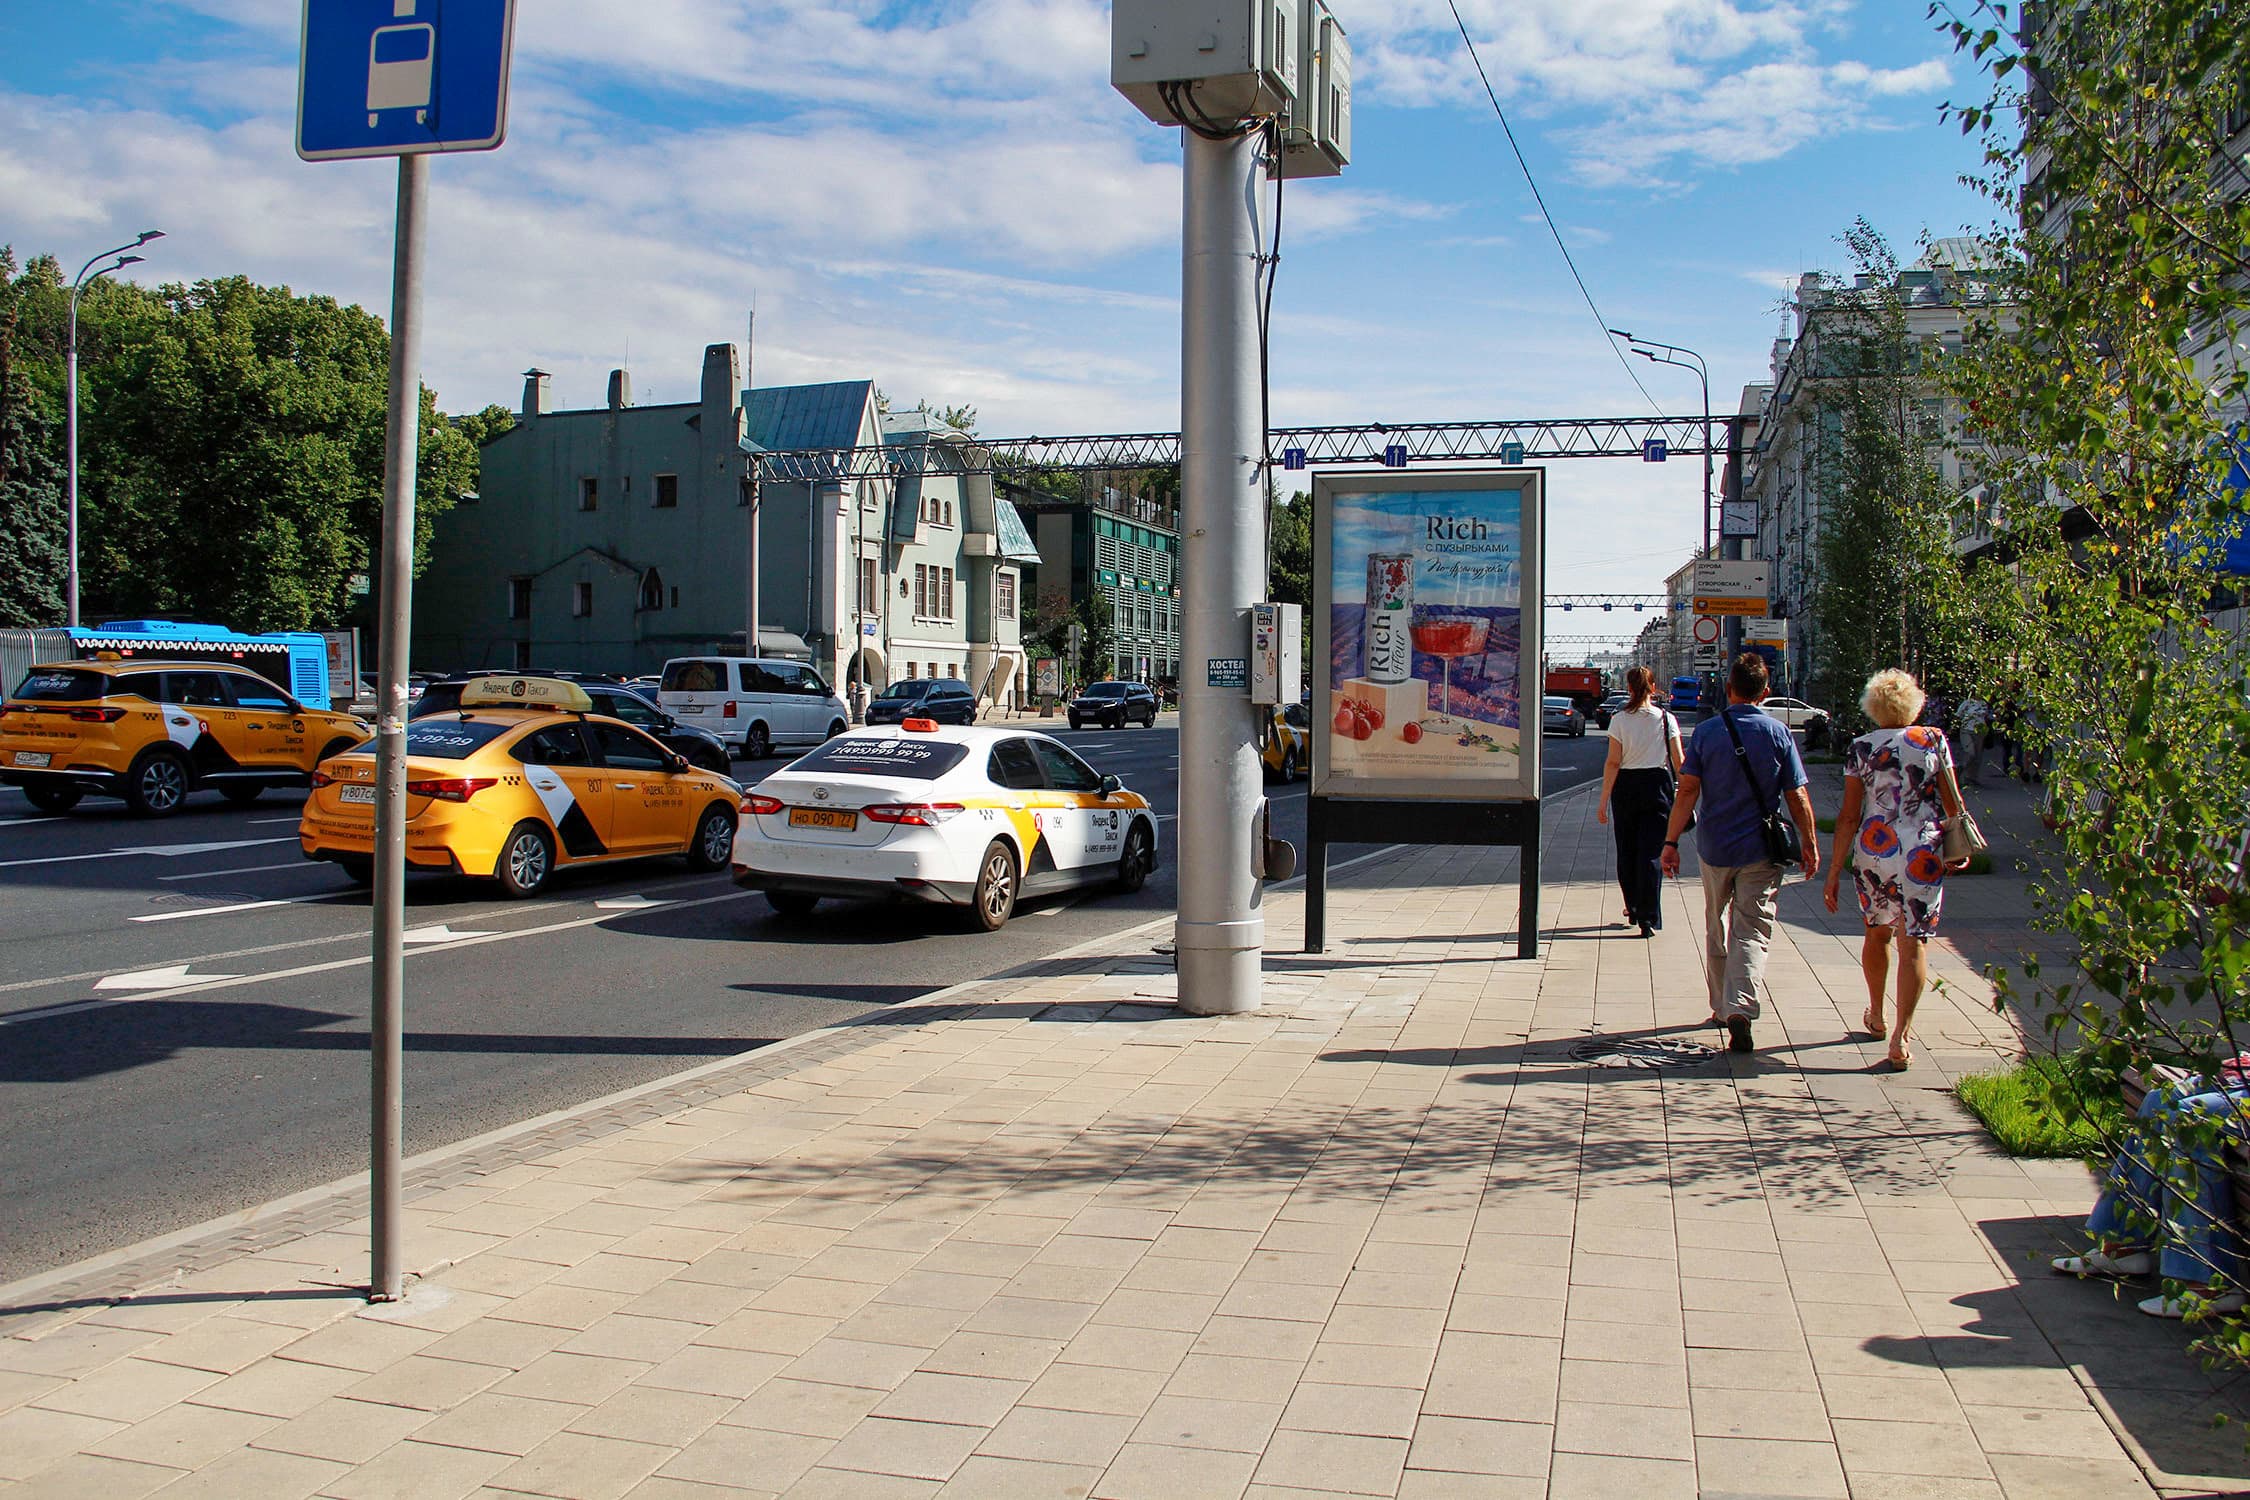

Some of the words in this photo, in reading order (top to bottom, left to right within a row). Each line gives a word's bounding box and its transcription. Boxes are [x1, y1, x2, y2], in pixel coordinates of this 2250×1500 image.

[1427, 516, 1487, 540] Rich
[1425, 543, 1433, 553] С
[1435, 543, 1509, 553] ПУЗЫРЬКАМИ
[1370, 615, 1391, 672] Rich
[1209, 660, 1245, 669] ХОСТЕЛ
[482, 681, 509, 695] Яндекс
[512, 681, 525, 695] Go
[527, 683, 549, 697] Такси
[223, 711, 237, 720] 223
[200, 722, 208, 733] Я
[267, 721, 292, 731] Яндекс
[844, 740, 879, 748] Яндекс
[900, 741, 927, 750] Такси
[896, 749, 913, 757] 99
[914, 750, 931, 759] 99
[332, 764, 352, 779] АКПП
[587, 778, 602, 793] 807
[641, 781, 665, 796] Яндекс
[665, 782, 684, 796] Такси
[795, 813, 809, 824] НО
[813, 812, 834, 825] 090
[840, 813, 852, 824] 77
[1092, 814, 1109, 827] Яндекс
[1105, 829, 1118, 841] Такси
